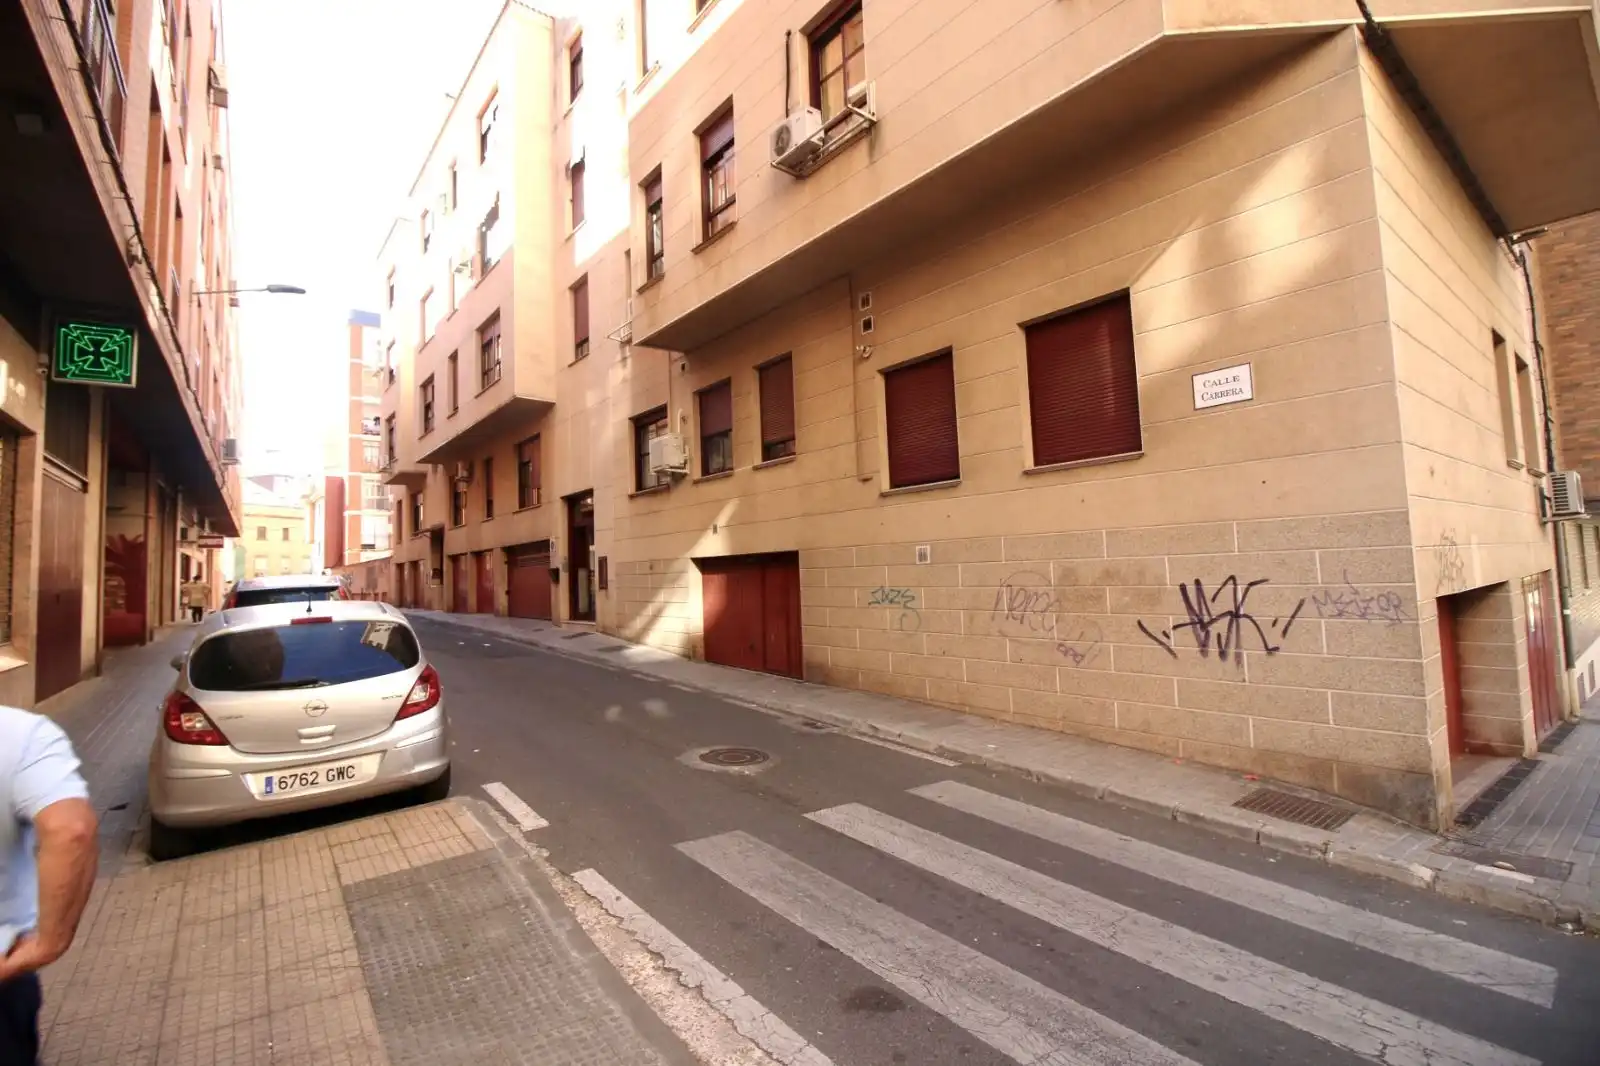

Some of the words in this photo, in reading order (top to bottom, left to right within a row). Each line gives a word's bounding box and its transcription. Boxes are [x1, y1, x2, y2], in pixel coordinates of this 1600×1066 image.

[1203, 375, 1240, 388] CALLE
[1201, 387, 1244, 402] CARRERA
[278, 771, 319, 790] 6762
[326, 765, 356, 782] GWC
